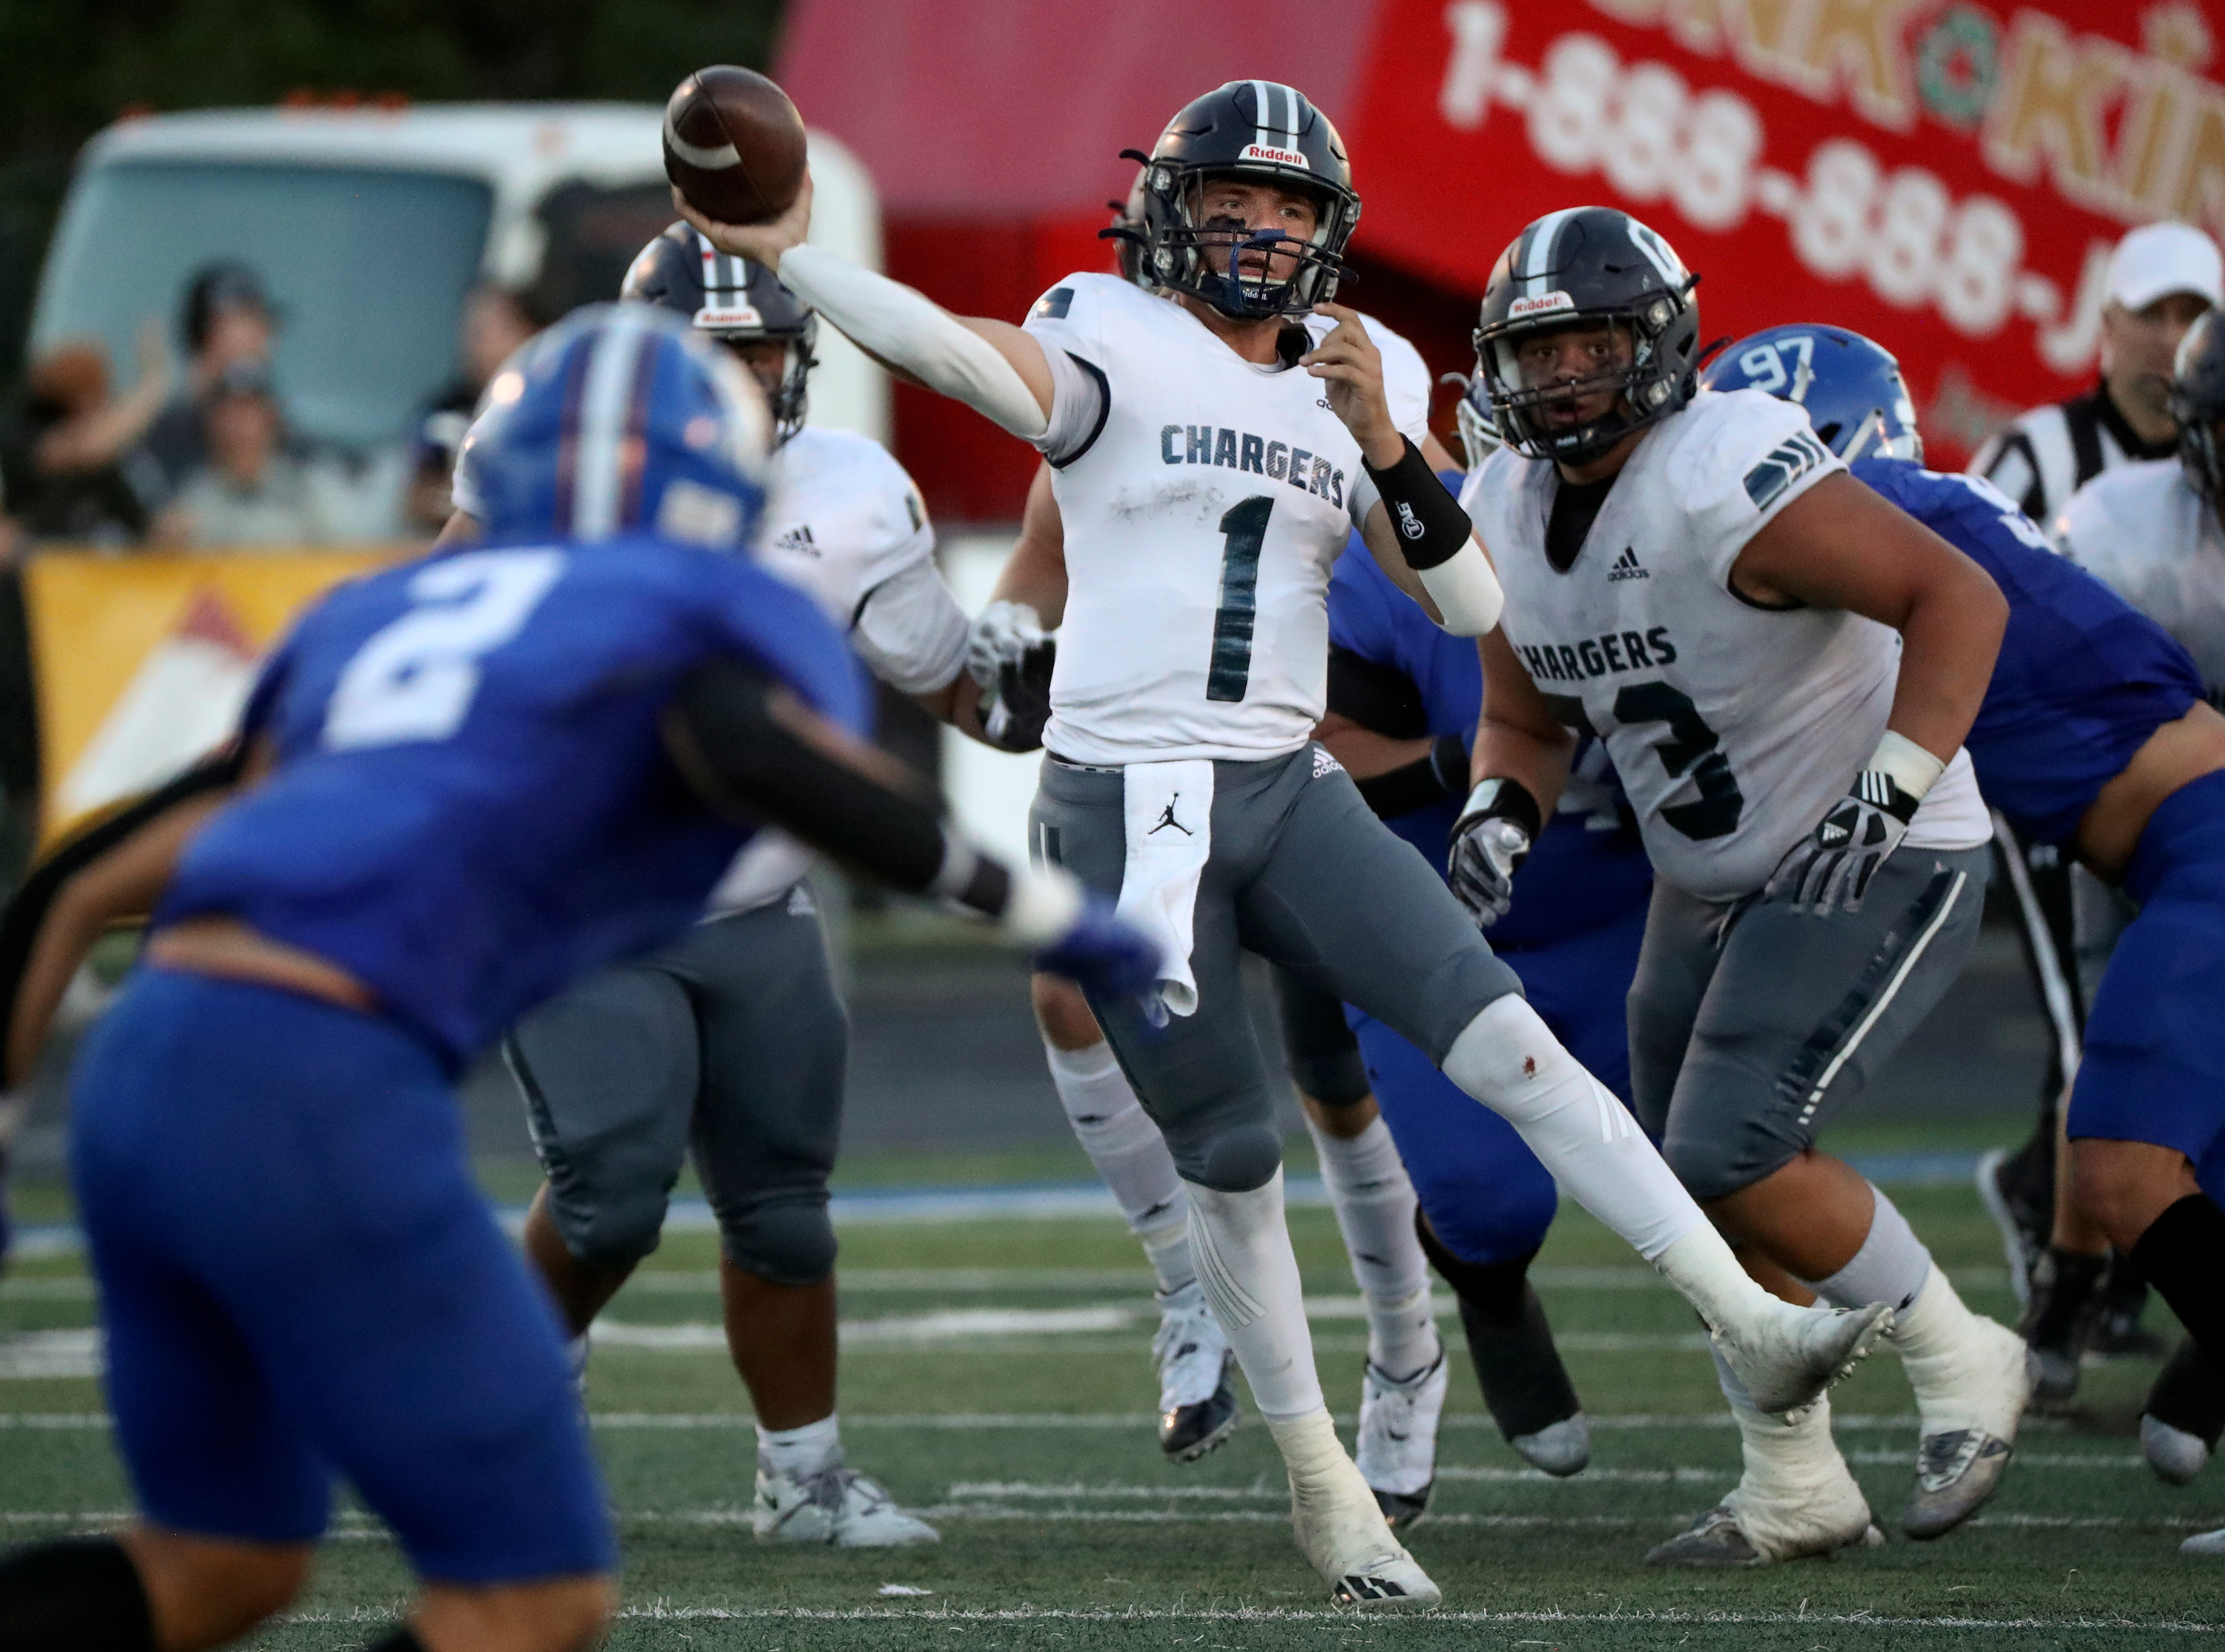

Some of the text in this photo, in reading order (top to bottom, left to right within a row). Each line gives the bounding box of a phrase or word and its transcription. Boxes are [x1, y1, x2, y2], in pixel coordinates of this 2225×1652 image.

[1250, 146, 1302, 165] Riddell
[1440, 0, 2115, 376] 1-888-888-J
[1514, 297, 1562, 313] Riddel
[1739, 336, 1816, 405] 97
[1161, 424, 1345, 510] CHARGERS
[1206, 495, 1275, 702] 1
[320, 547, 567, 752] 2
[1516, 626, 1678, 681] HARGERS
[1541, 680, 1744, 842] 3
